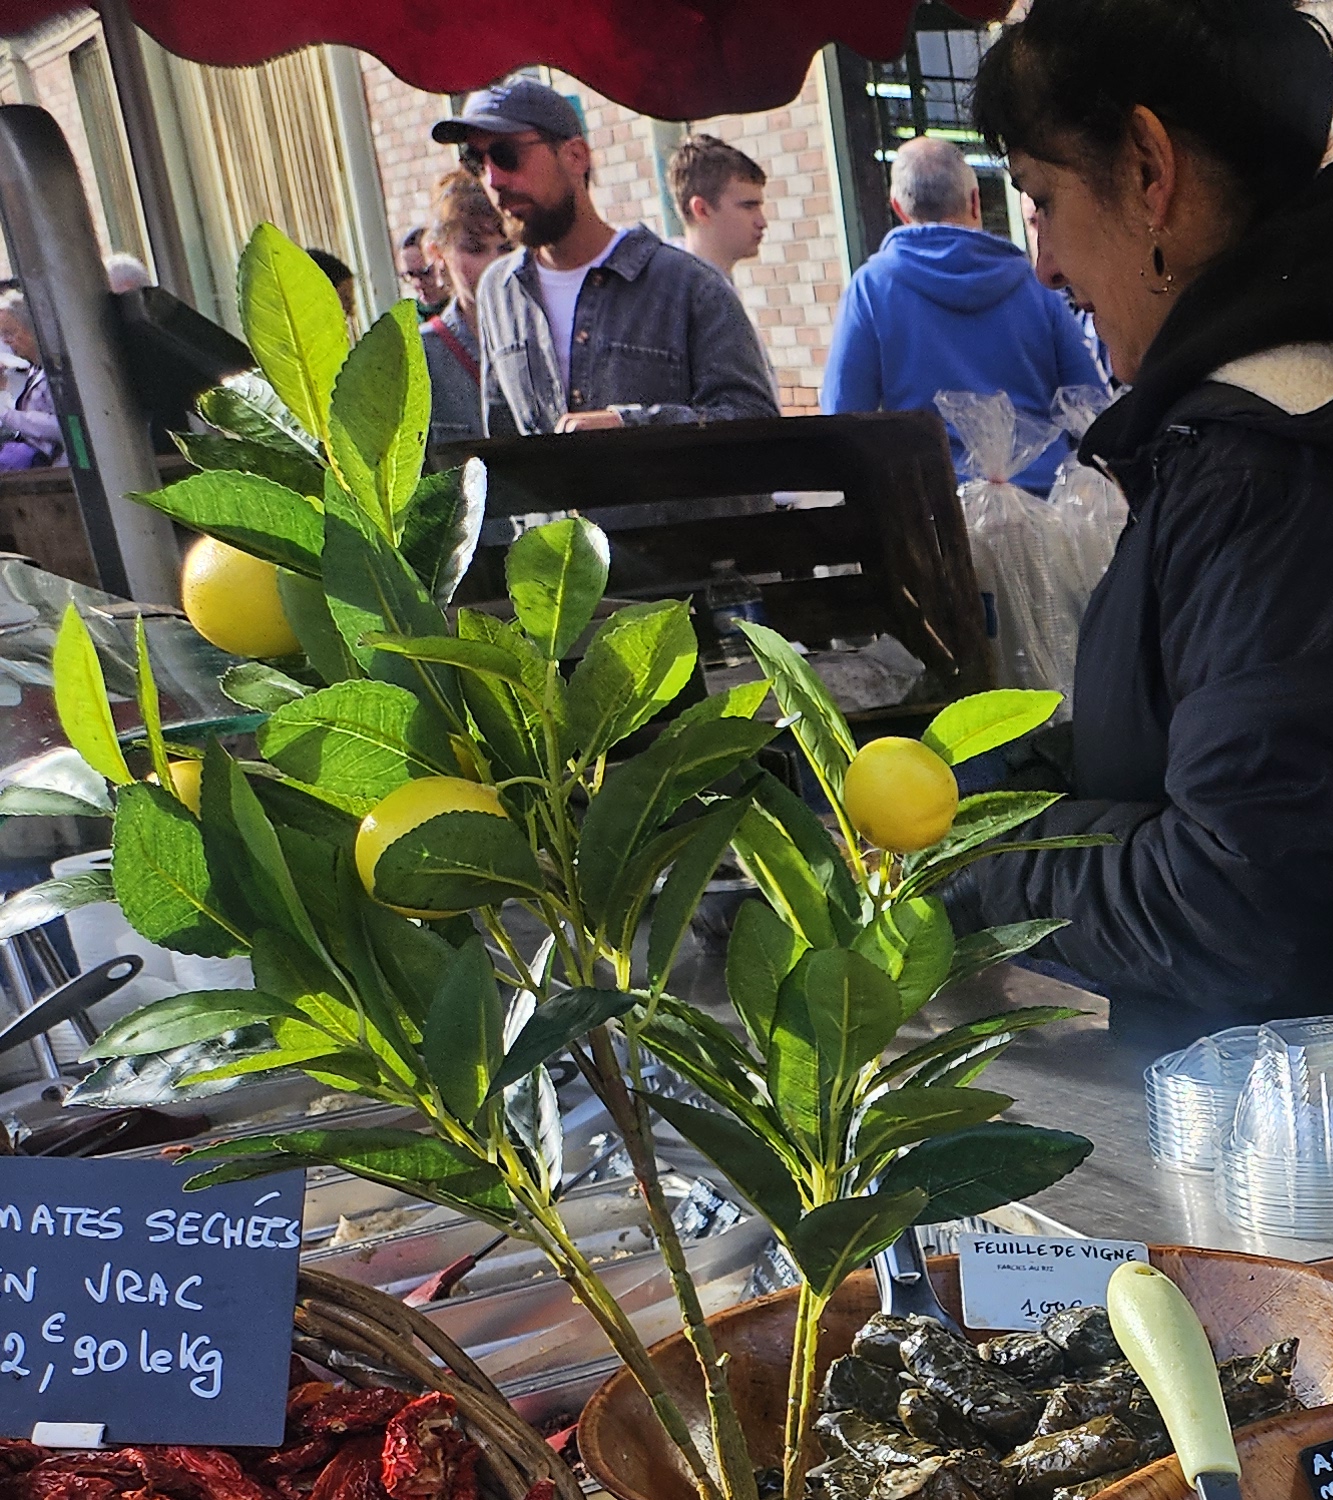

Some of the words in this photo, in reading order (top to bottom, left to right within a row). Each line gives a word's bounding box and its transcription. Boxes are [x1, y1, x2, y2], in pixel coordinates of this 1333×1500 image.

[974, 1240, 1048, 1257] FEUILLE
[1050, 1244, 1076, 1258] DE
[1080, 1245, 1138, 1262] VIGNE
[0, 1265, 37, 1302] N
[85, 1262, 203, 1310] VRAC
